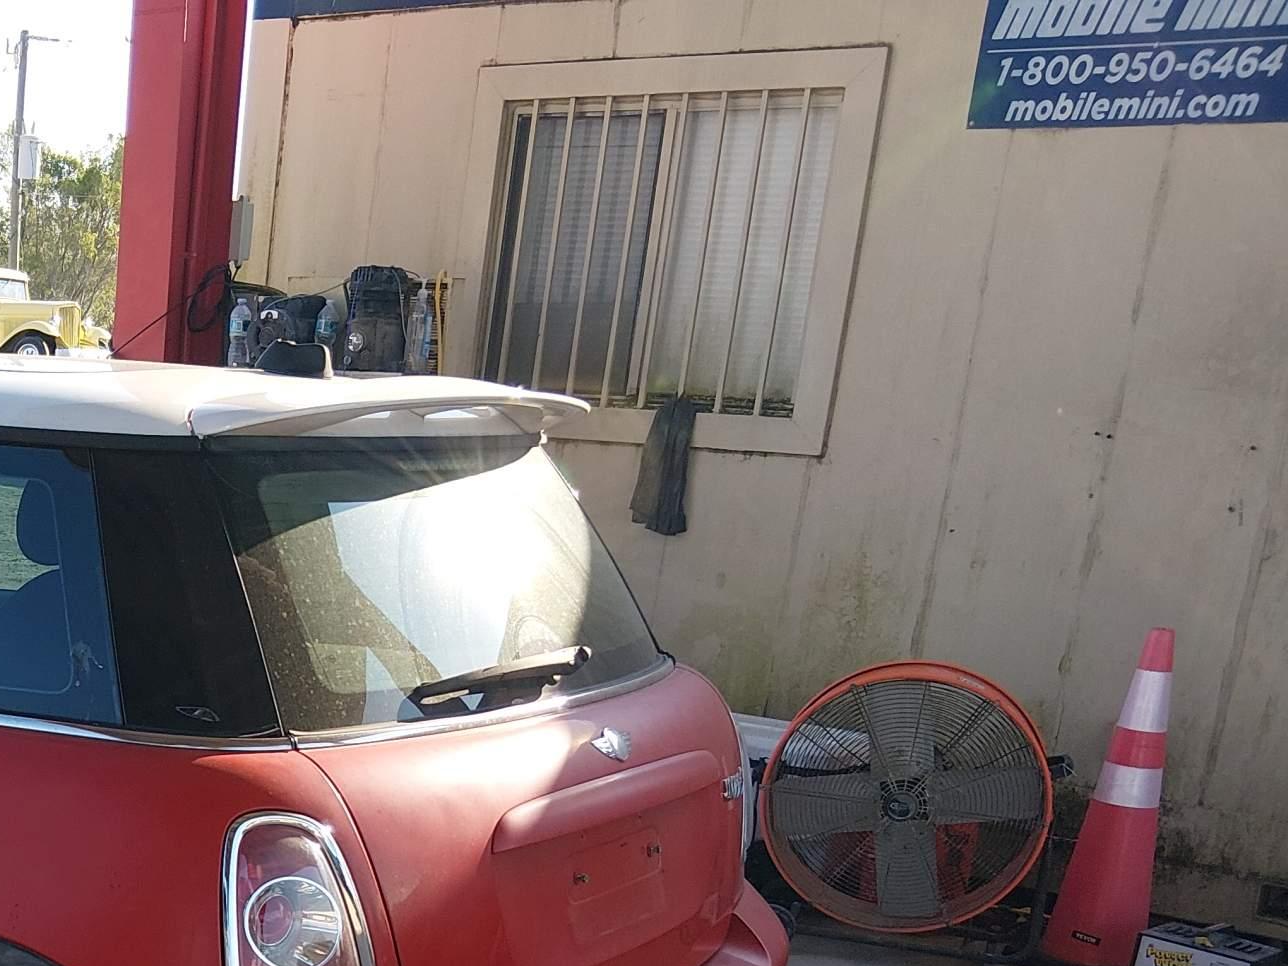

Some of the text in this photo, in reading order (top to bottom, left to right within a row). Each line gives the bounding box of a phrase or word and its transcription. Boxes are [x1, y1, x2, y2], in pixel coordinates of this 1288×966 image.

[992, 0, 1172, 39] mobile
[996, 44, 1287, 86] 1-800-950-6464
[1004, 88, 1260, 121] mobilemini.com
